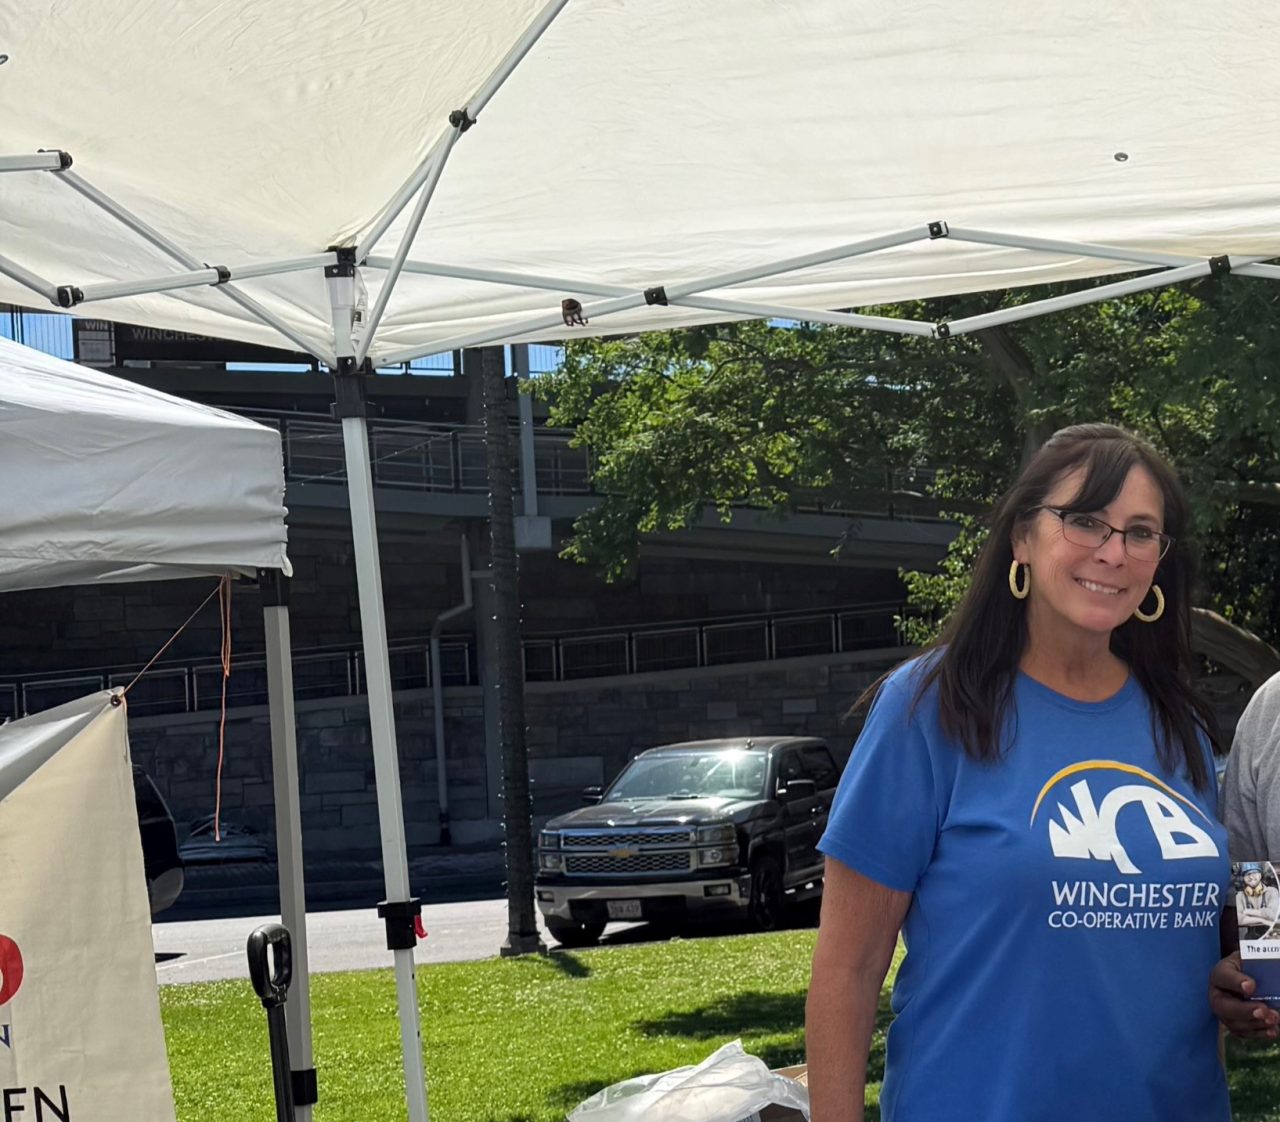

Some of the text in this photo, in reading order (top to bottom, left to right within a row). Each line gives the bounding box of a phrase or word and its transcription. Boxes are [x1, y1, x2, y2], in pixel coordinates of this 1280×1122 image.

[1052, 881, 1220, 907] WINCHESTER
[1048, 911, 1216, 929] CO-OPERATIVE BANK
[1247, 945, 1261, 953] The
